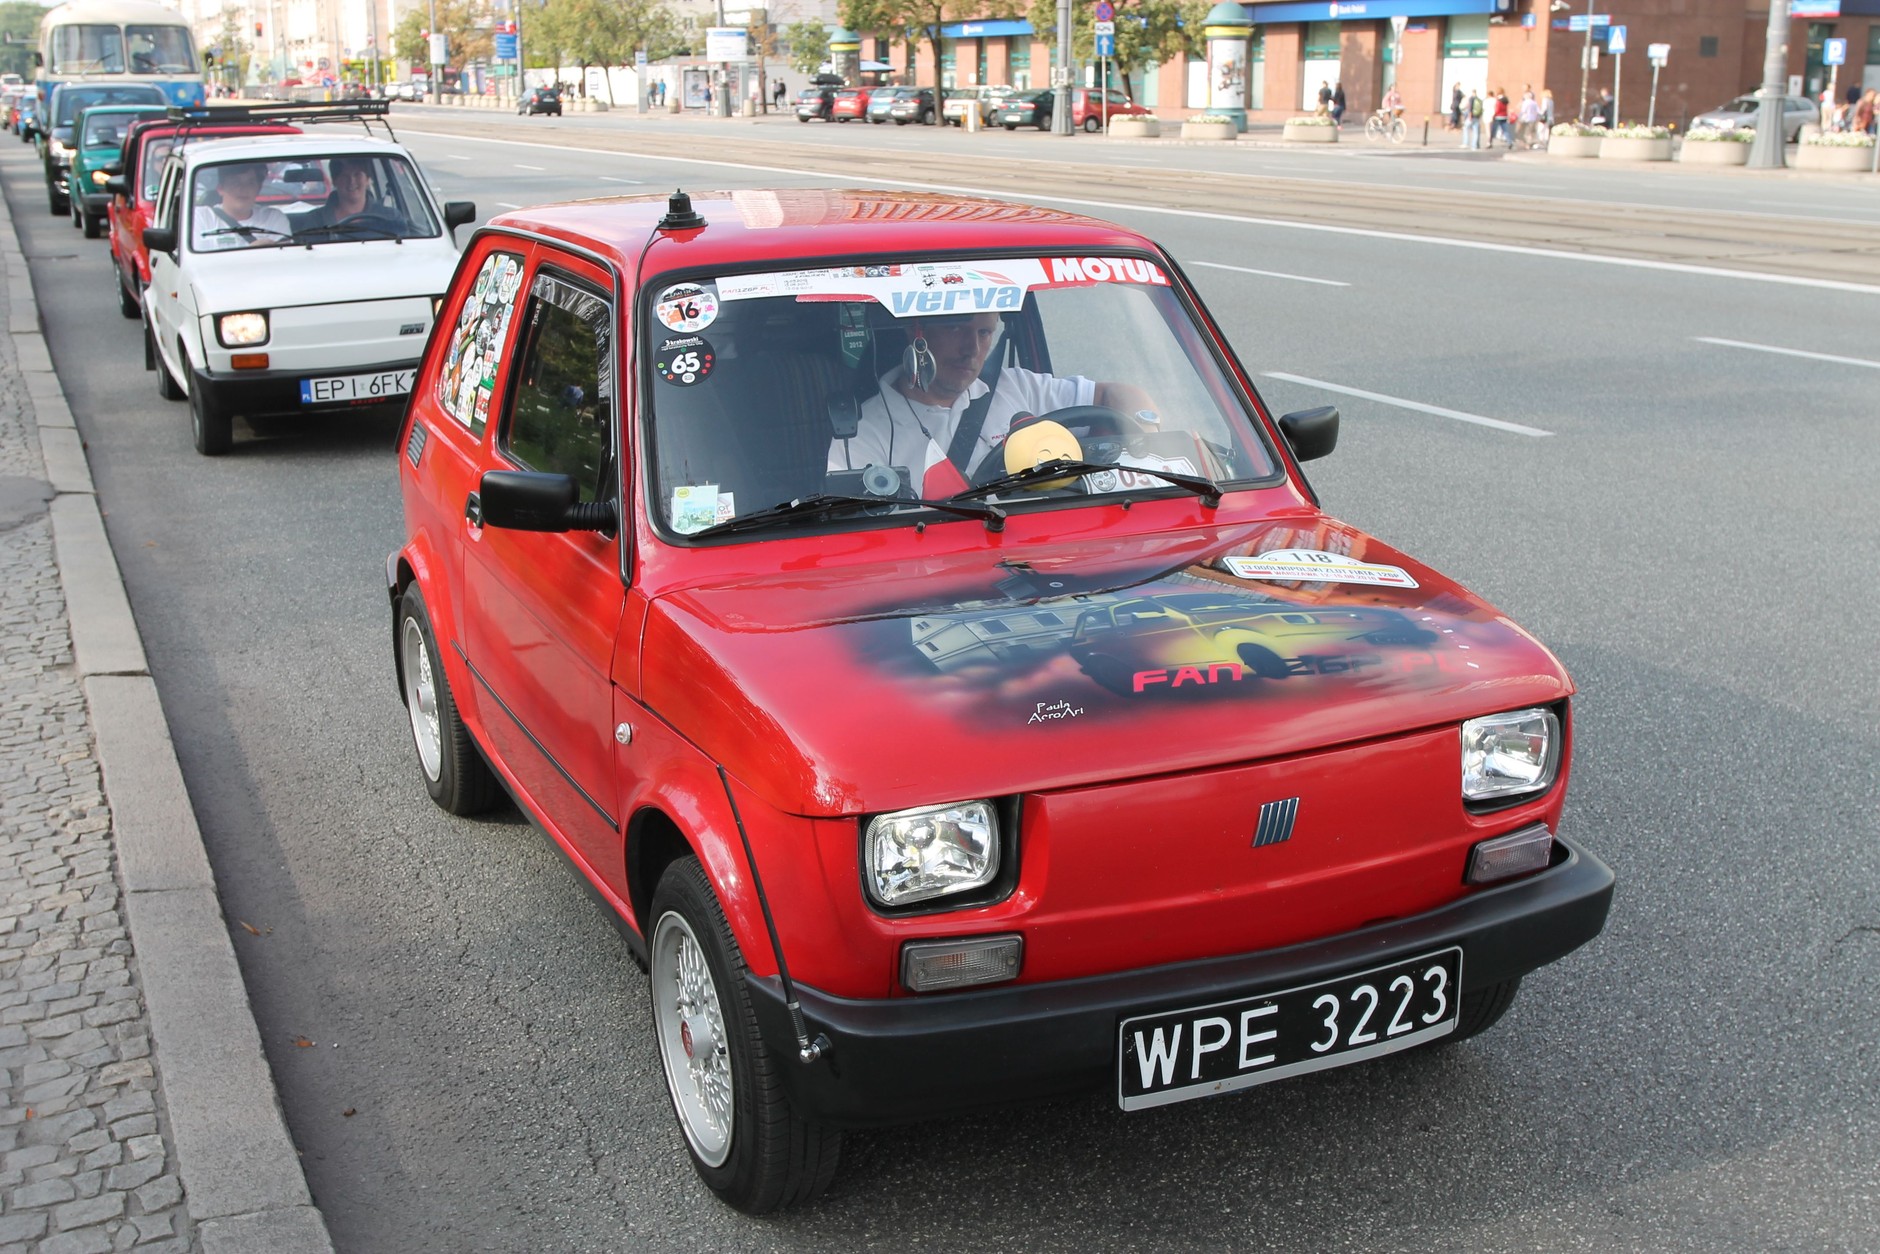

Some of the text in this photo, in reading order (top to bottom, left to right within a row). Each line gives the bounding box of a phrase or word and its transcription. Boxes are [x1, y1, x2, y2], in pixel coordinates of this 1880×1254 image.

[1051, 257, 1166, 285] MOTUL
[674, 301, 700, 321] 16
[891, 286, 1022, 314] verva
[671, 351, 700, 374] 65
[1290, 552, 1332, 563] 118
[1036, 699, 1070, 714] Paula
[1134, 965, 1448, 1089] WPE 3223
